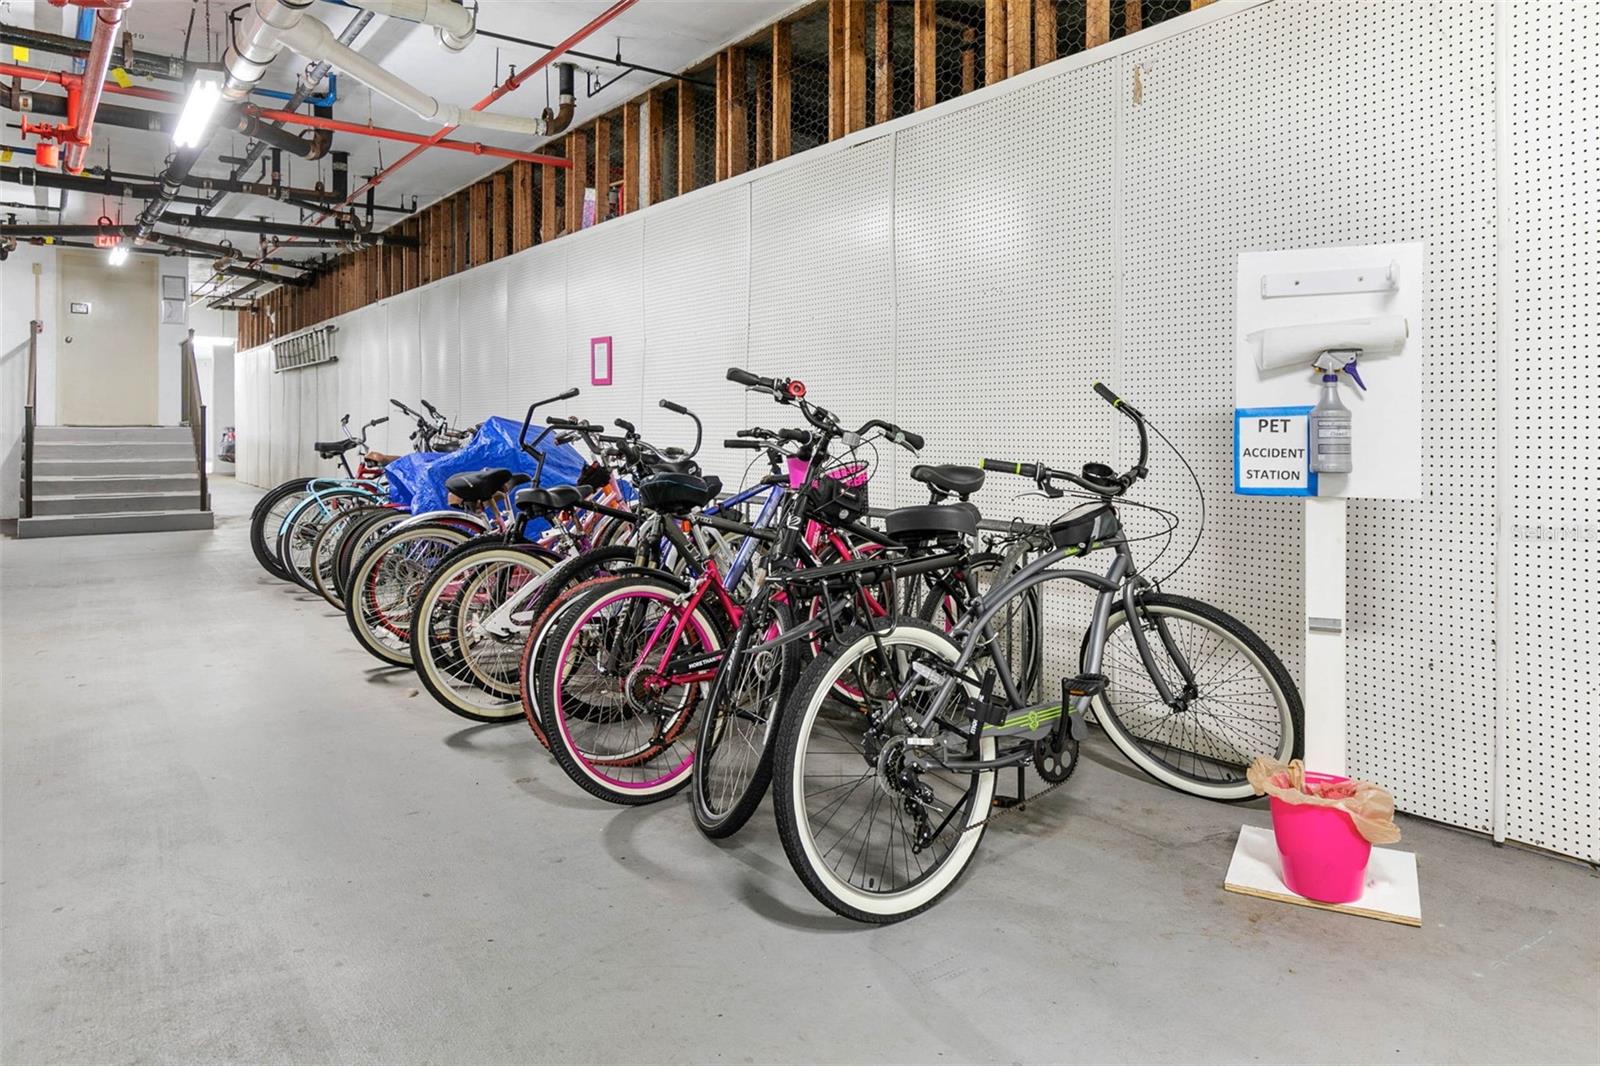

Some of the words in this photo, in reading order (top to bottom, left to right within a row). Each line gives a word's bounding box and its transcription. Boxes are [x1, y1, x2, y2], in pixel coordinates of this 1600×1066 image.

[1258, 419, 1291, 433] PET
[1243, 448, 1305, 459] ACCIDENT
[1246, 469, 1300, 481] STATION
